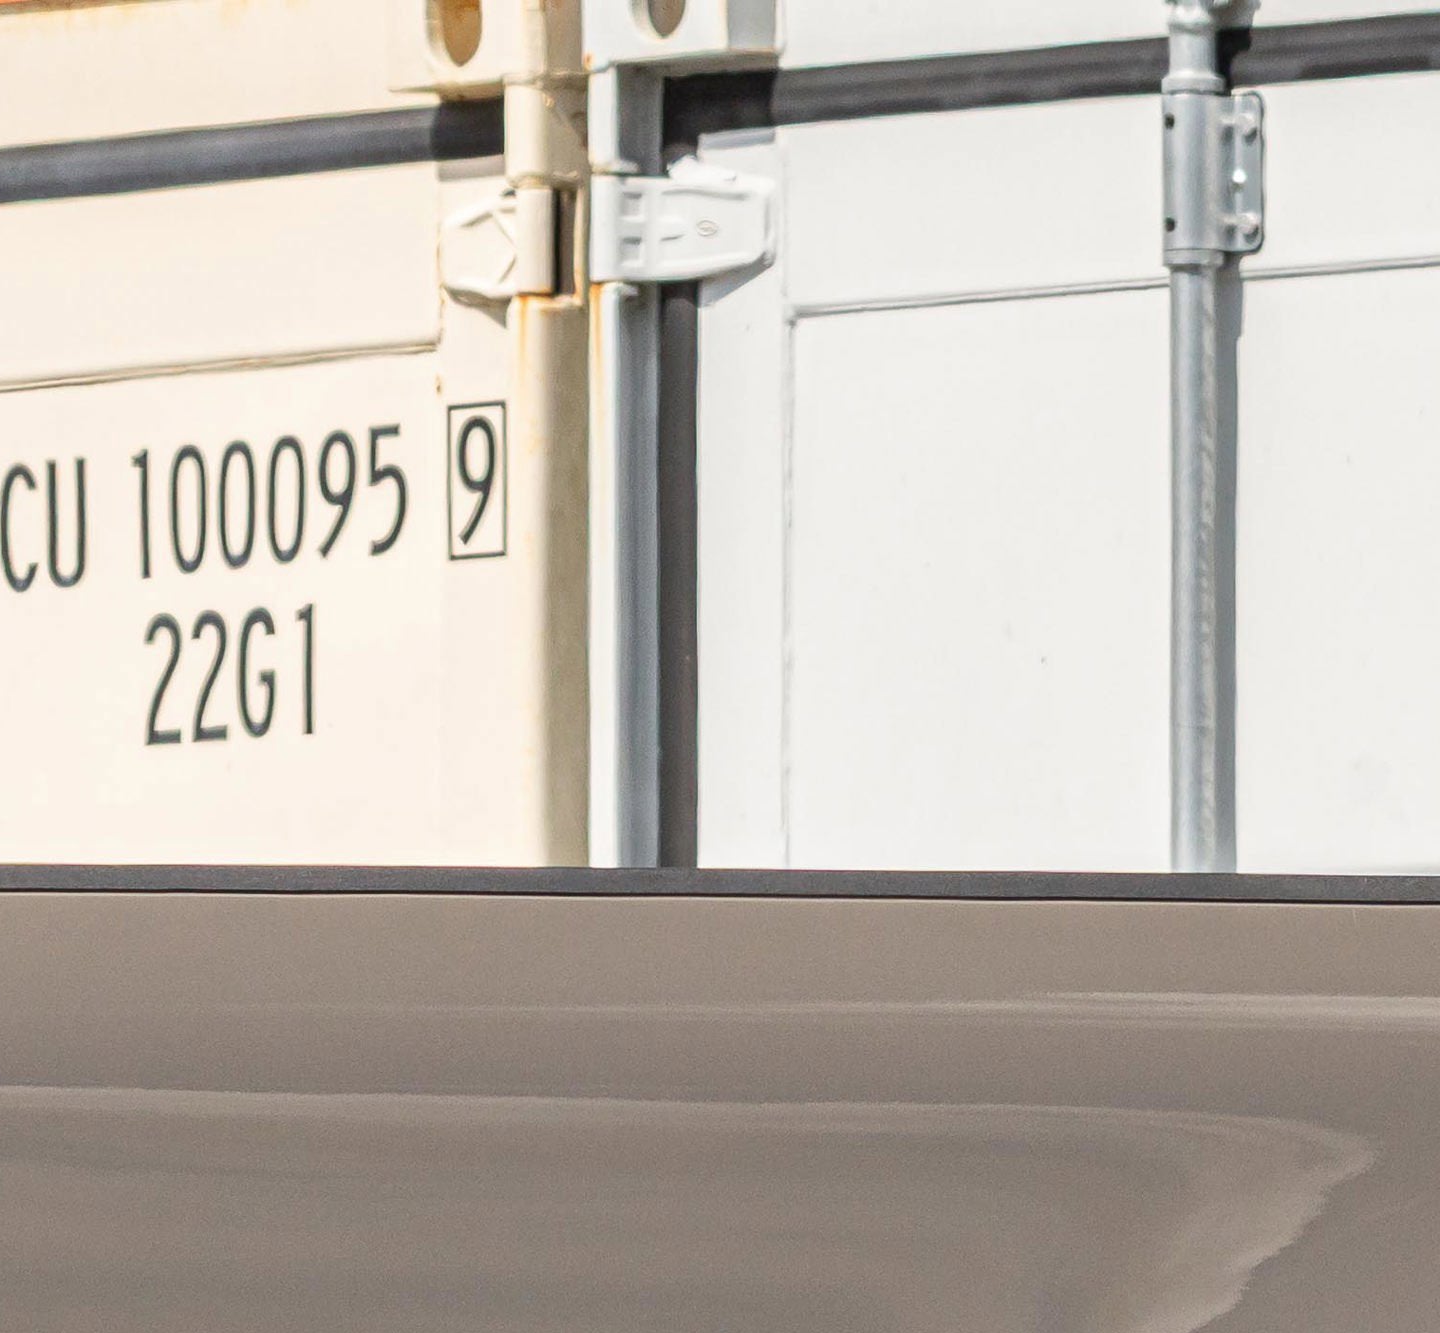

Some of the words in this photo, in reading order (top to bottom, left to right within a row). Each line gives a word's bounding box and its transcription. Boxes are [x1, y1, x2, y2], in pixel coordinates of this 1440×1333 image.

[133, 424, 406, 578] 100095
[457, 415, 497, 547] 9
[146, 604, 313, 745] 22G1
